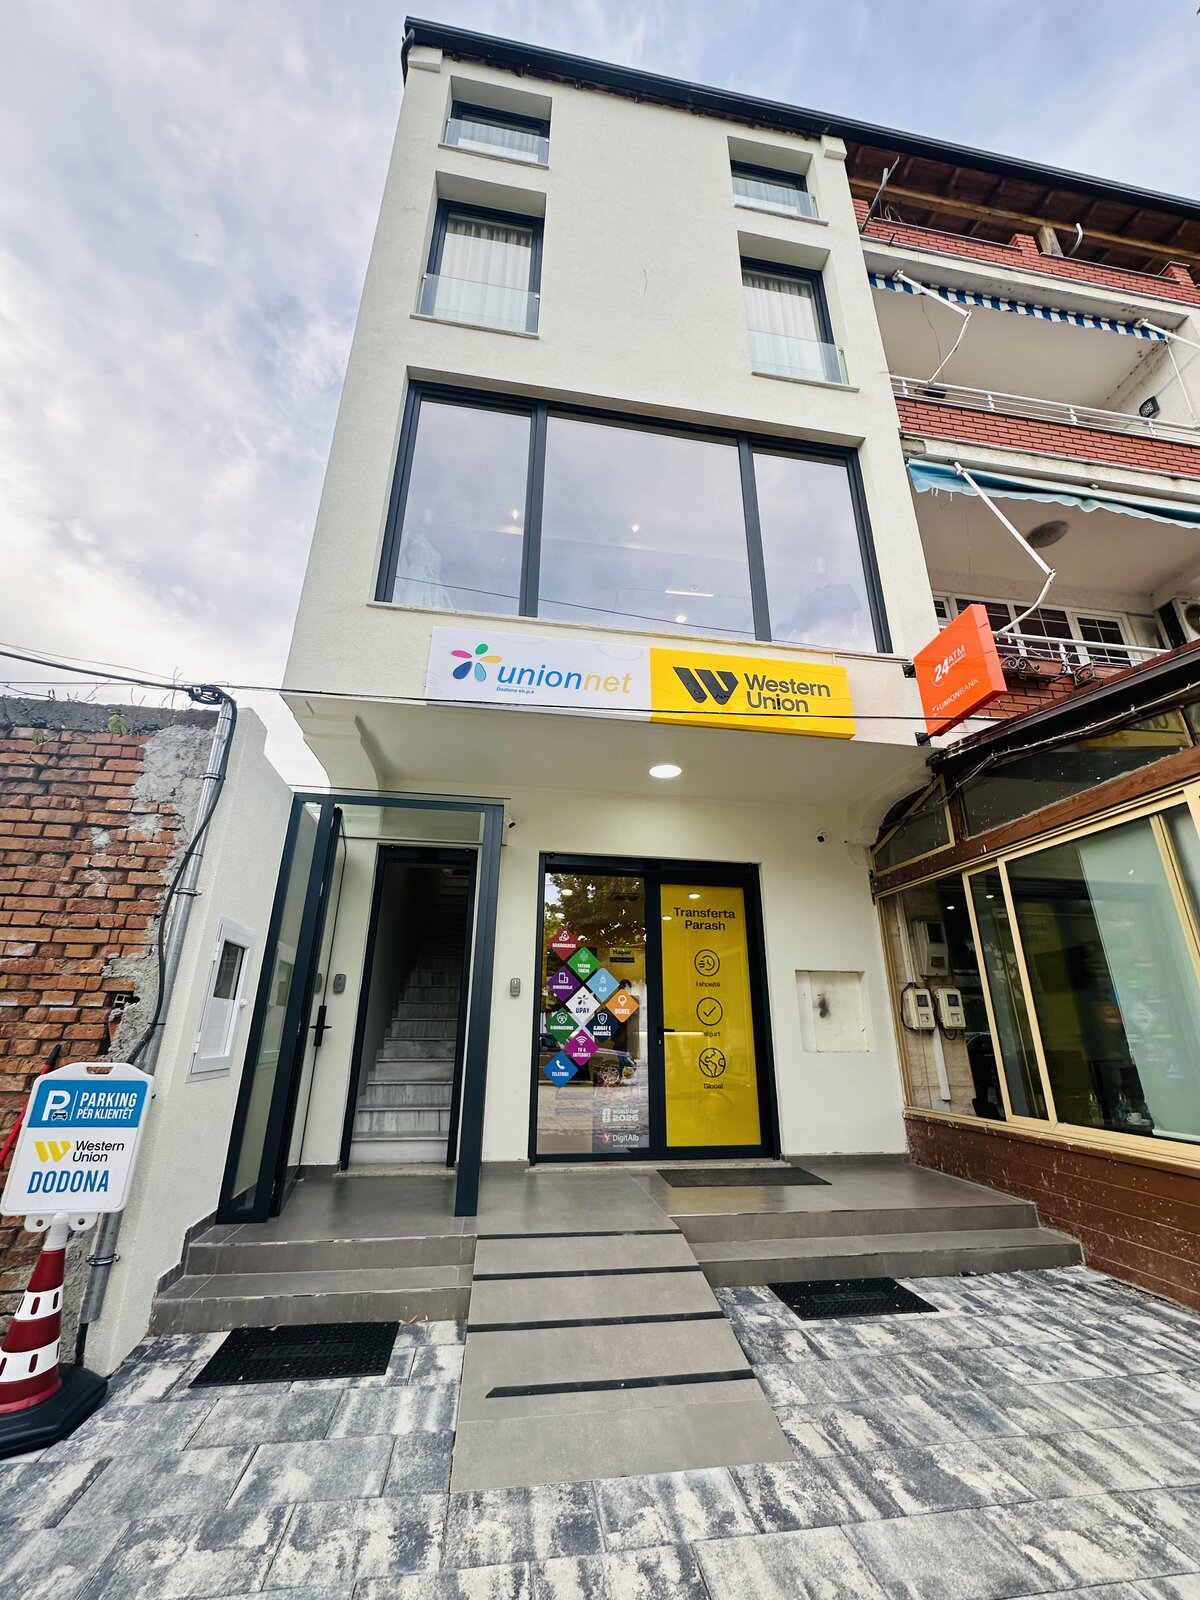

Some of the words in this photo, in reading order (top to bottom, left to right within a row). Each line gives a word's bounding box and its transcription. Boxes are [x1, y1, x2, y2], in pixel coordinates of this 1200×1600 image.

[934, 656, 949, 683] 24
[948, 644, 966, 664] ATM
[497, 665, 632, 694] unionnet
[744, 673, 831, 698] Western
[746, 691, 809, 713] Union
[939, 678, 979, 711] UNIONBANK
[673, 907, 736, 919] Transferta
[685, 920, 726, 931] Parash
[79, 1092, 138, 1108] PARKING
[76, 1107, 94, 1120] PËR
[94, 1106, 135, 1120] KLIENTËT
[612, 1114, 639, 1122] 2026
[612, 1133, 639, 1143] DigitAlb
[75, 1140, 125, 1152] Western
[72, 1151, 108, 1163] Union
[27, 1170, 110, 1194] DODONA
